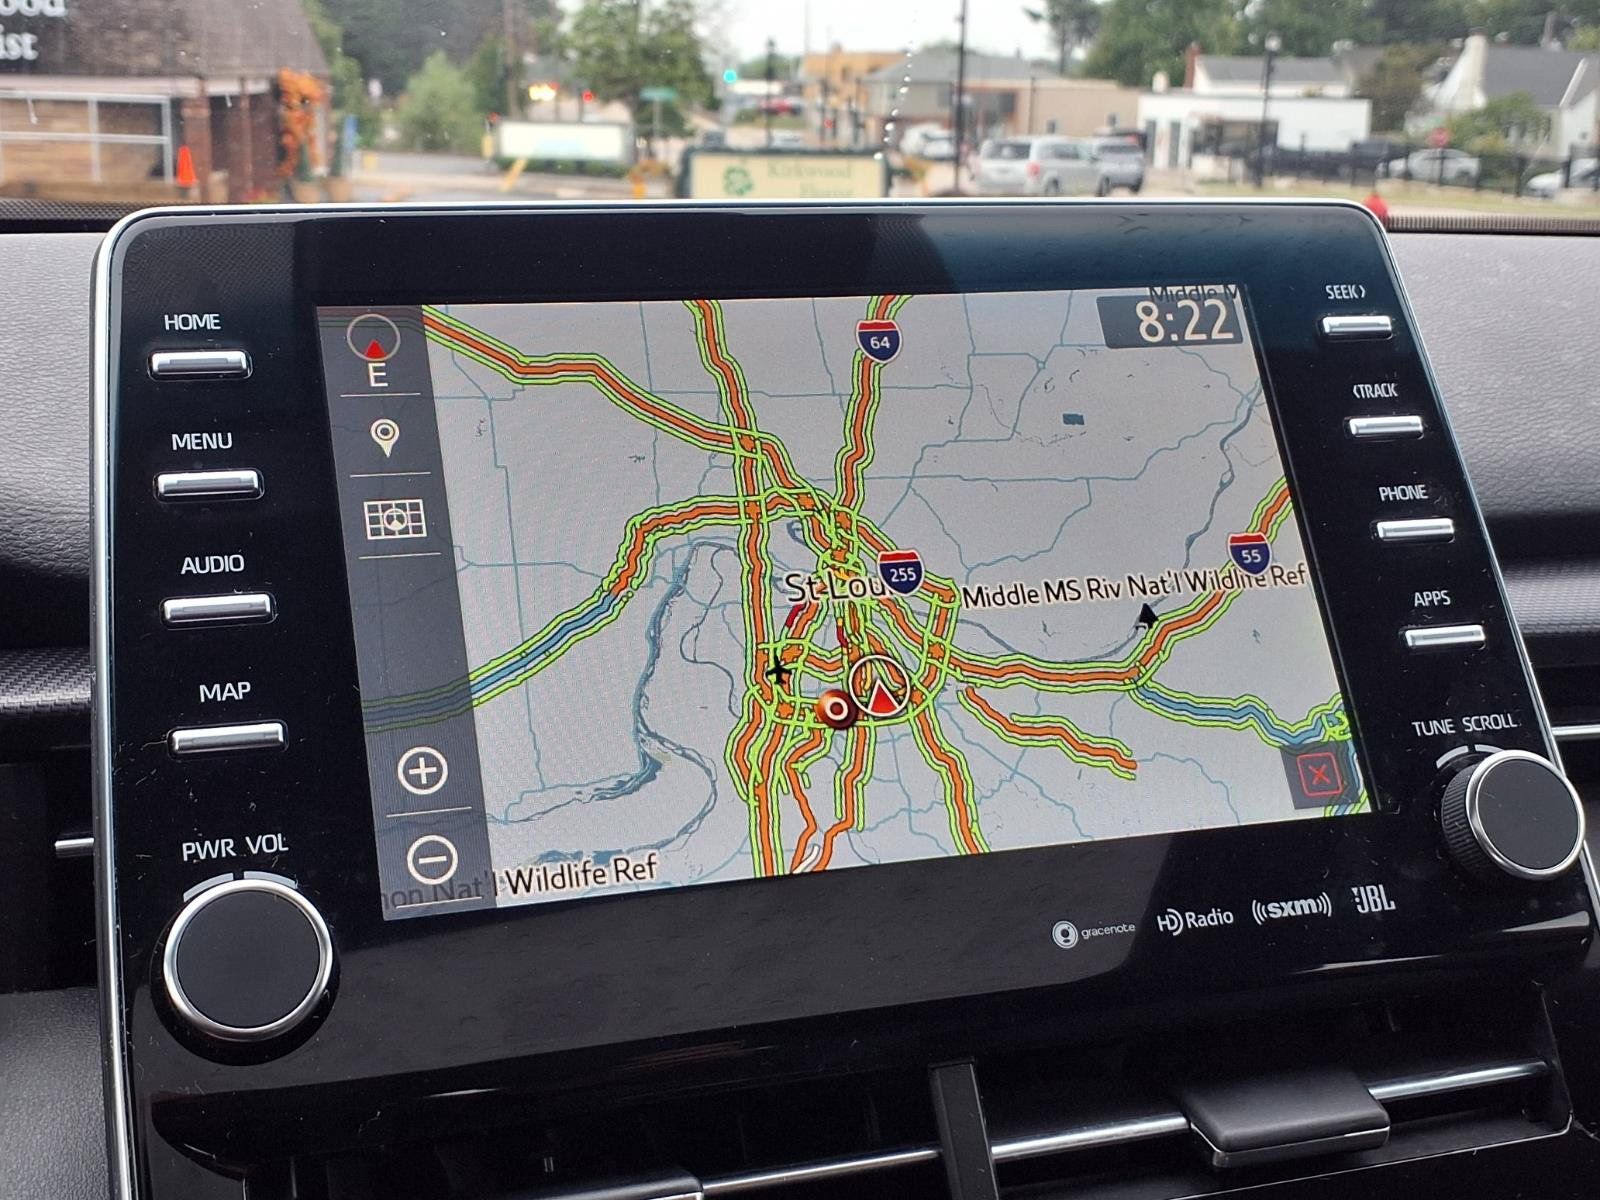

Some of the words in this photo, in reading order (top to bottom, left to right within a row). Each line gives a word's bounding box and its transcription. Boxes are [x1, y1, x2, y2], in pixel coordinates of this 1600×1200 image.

[1325, 284, 1359, 299] SEEK
[164, 313, 221, 331] HOME
[1135, 298, 1234, 343] 8:22
[870, 336, 891, 349] 64
[368, 362, 389, 387] E
[1359, 382, 1398, 399] TRACK
[171, 432, 233, 451] MENU
[1378, 484, 1429, 501] PHONE
[180, 554, 245, 575] AUDIO
[1241, 549, 1262, 564] 55
[785, 574, 821, 601] St
[828, 568, 894, 600] Lou
[889, 567, 917, 583] 255
[962, 583, 1039, 609] Middle
[1043, 579, 1082, 603] MS
[1086, 577, 1121, 600] Riv
[1127, 570, 1182, 597] Nat'l
[1270, 563, 1306, 586] Ref
[1413, 589, 1452, 607] APPS
[199, 681, 252, 703] MAP
[1411, 718, 1457, 737] TUNE
[1462, 712, 1518, 732] SCROLL
[182, 838, 237, 862] PWR
[245, 832, 290, 855] VOL
[505, 859, 607, 896] Wildlife
[614, 853, 658, 882] Ref
[1351, 883, 1397, 914] JBL
[1081, 923, 1136, 940] gracenote
[1157, 908, 1184, 936] HD
[1185, 908, 1234, 928] Radio
